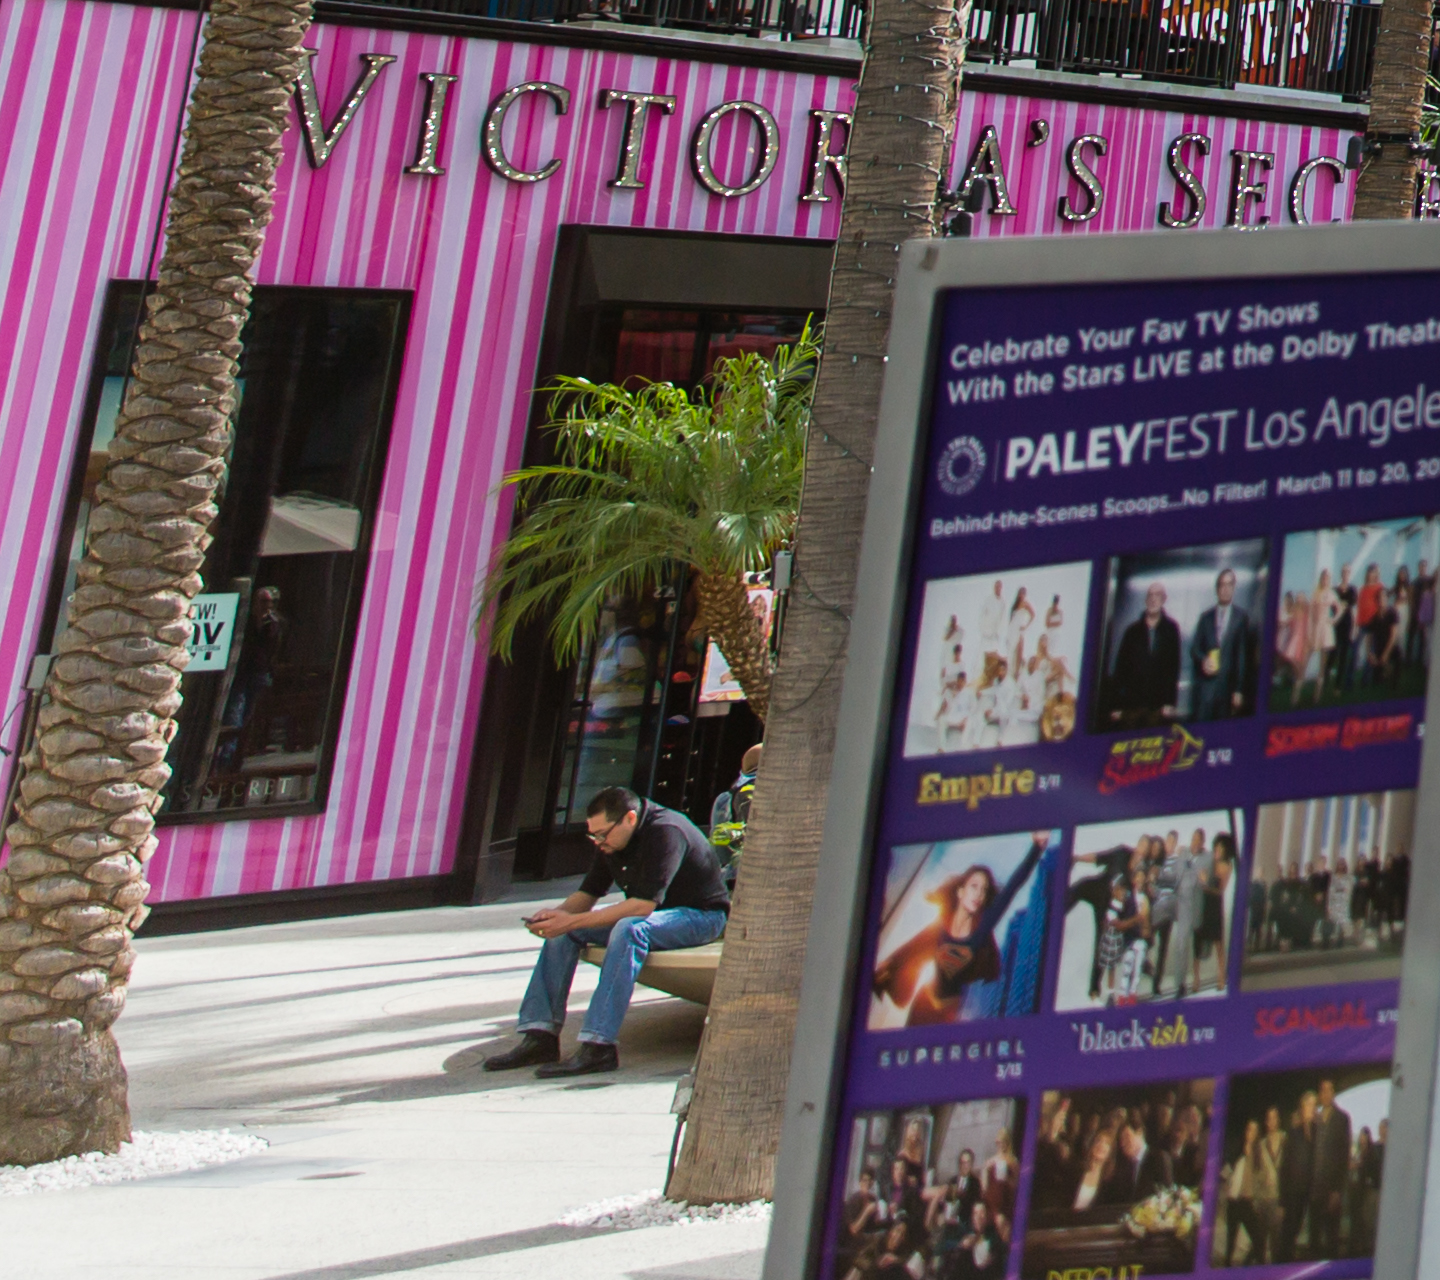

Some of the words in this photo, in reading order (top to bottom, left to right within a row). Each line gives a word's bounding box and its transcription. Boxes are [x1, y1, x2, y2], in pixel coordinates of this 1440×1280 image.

[295, 43, 1108, 224] VICTORA'S
[948, 375, 1005, 407] With
[1014, 368, 1054, 397] the
[1062, 360, 1125, 393] Stars
[1133, 350, 1192, 383] LIVE
[1198, 349, 1226, 373] at
[1232, 340, 1274, 368] the
[1282, 329, 1357, 365] Dolby
[950, 331, 1069, 371] Celebrate
[1079, 323, 1134, 354] Your
[1142, 316, 1186, 345] Fav
[1197, 308, 1232, 336] TV
[1238, 301, 1320, 333] Shows
[1005, 408, 1239, 481] PALEYFEST
[1244, 407, 1306, 451] Los
[930, 502, 1098, 538] Behind-the-Scenes
[1214, 478, 1267, 505] Filter!
[1277, 470, 1332, 498] March
[1356, 465, 1377, 488] to
[917, 763, 1035, 810] Empire
[880, 1040, 1025, 1068] SUPERGIRL
